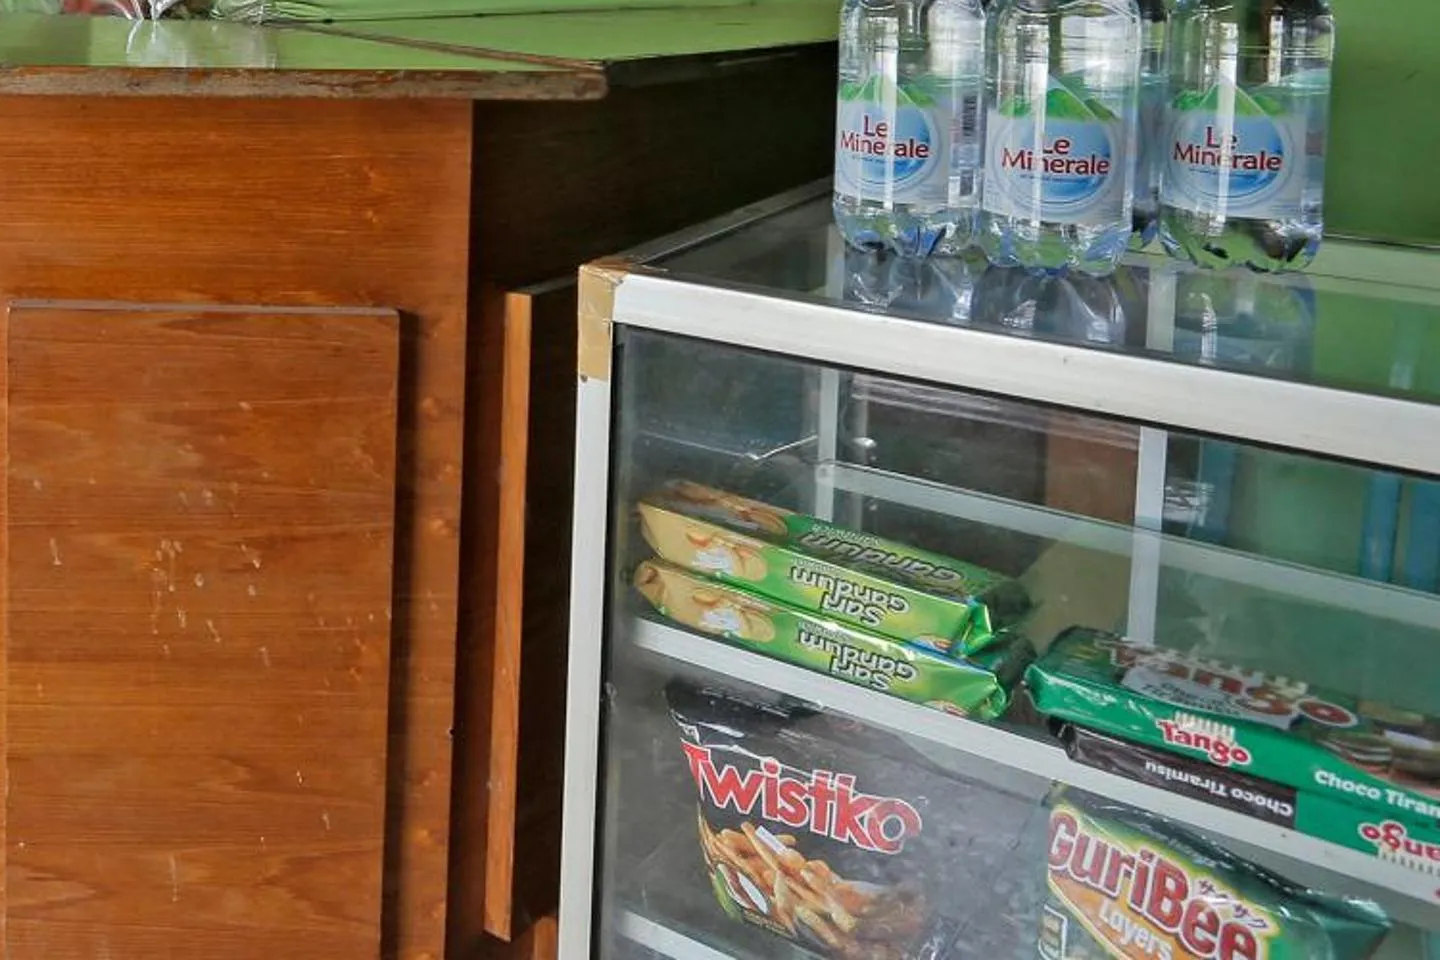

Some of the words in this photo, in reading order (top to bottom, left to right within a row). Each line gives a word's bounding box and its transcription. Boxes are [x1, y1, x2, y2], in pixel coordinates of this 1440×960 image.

[840, 130, 929, 158] Mineale
[863, 115, 888, 137] Le
[800, 533, 964, 585] Gandum
[790, 565, 910, 614] Gandum
[821, 591, 885, 628] Sari
[798, 630, 918, 684] Gandum
[829, 654, 893, 691] Sari
[1157, 719, 1252, 767] Tango
[681, 740, 923, 855] Twistko
[1145, 759, 1228, 798] Tiramisu
[1314, 768, 1382, 801] Choco
[1231, 787, 1294, 818] Choco
[1358, 819, 1440, 862] ango
[1048, 810, 1259, 960] GuriBee
